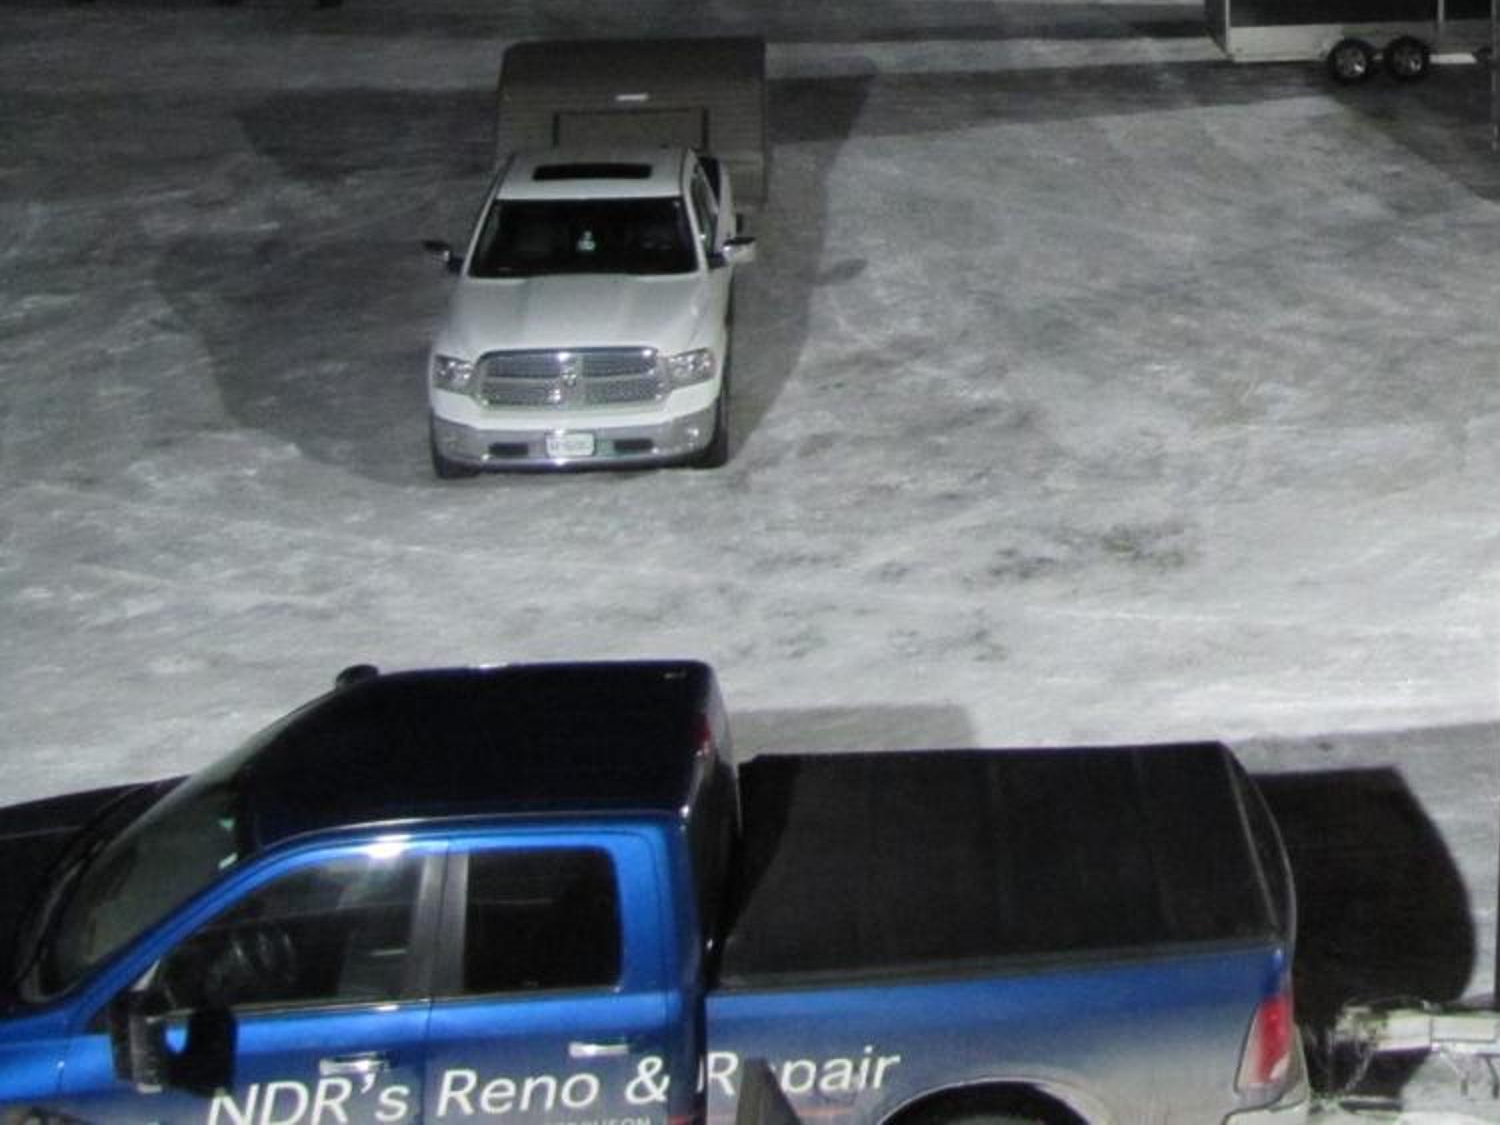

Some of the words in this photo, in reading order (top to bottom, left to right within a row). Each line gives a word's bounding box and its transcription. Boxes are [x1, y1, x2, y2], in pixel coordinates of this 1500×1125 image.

[207, 1073, 410, 1125] NDR's
[436, 1068, 600, 1117] Reno
[624, 1056, 671, 1106] &
[696, 1044, 901, 1096] Rpair
